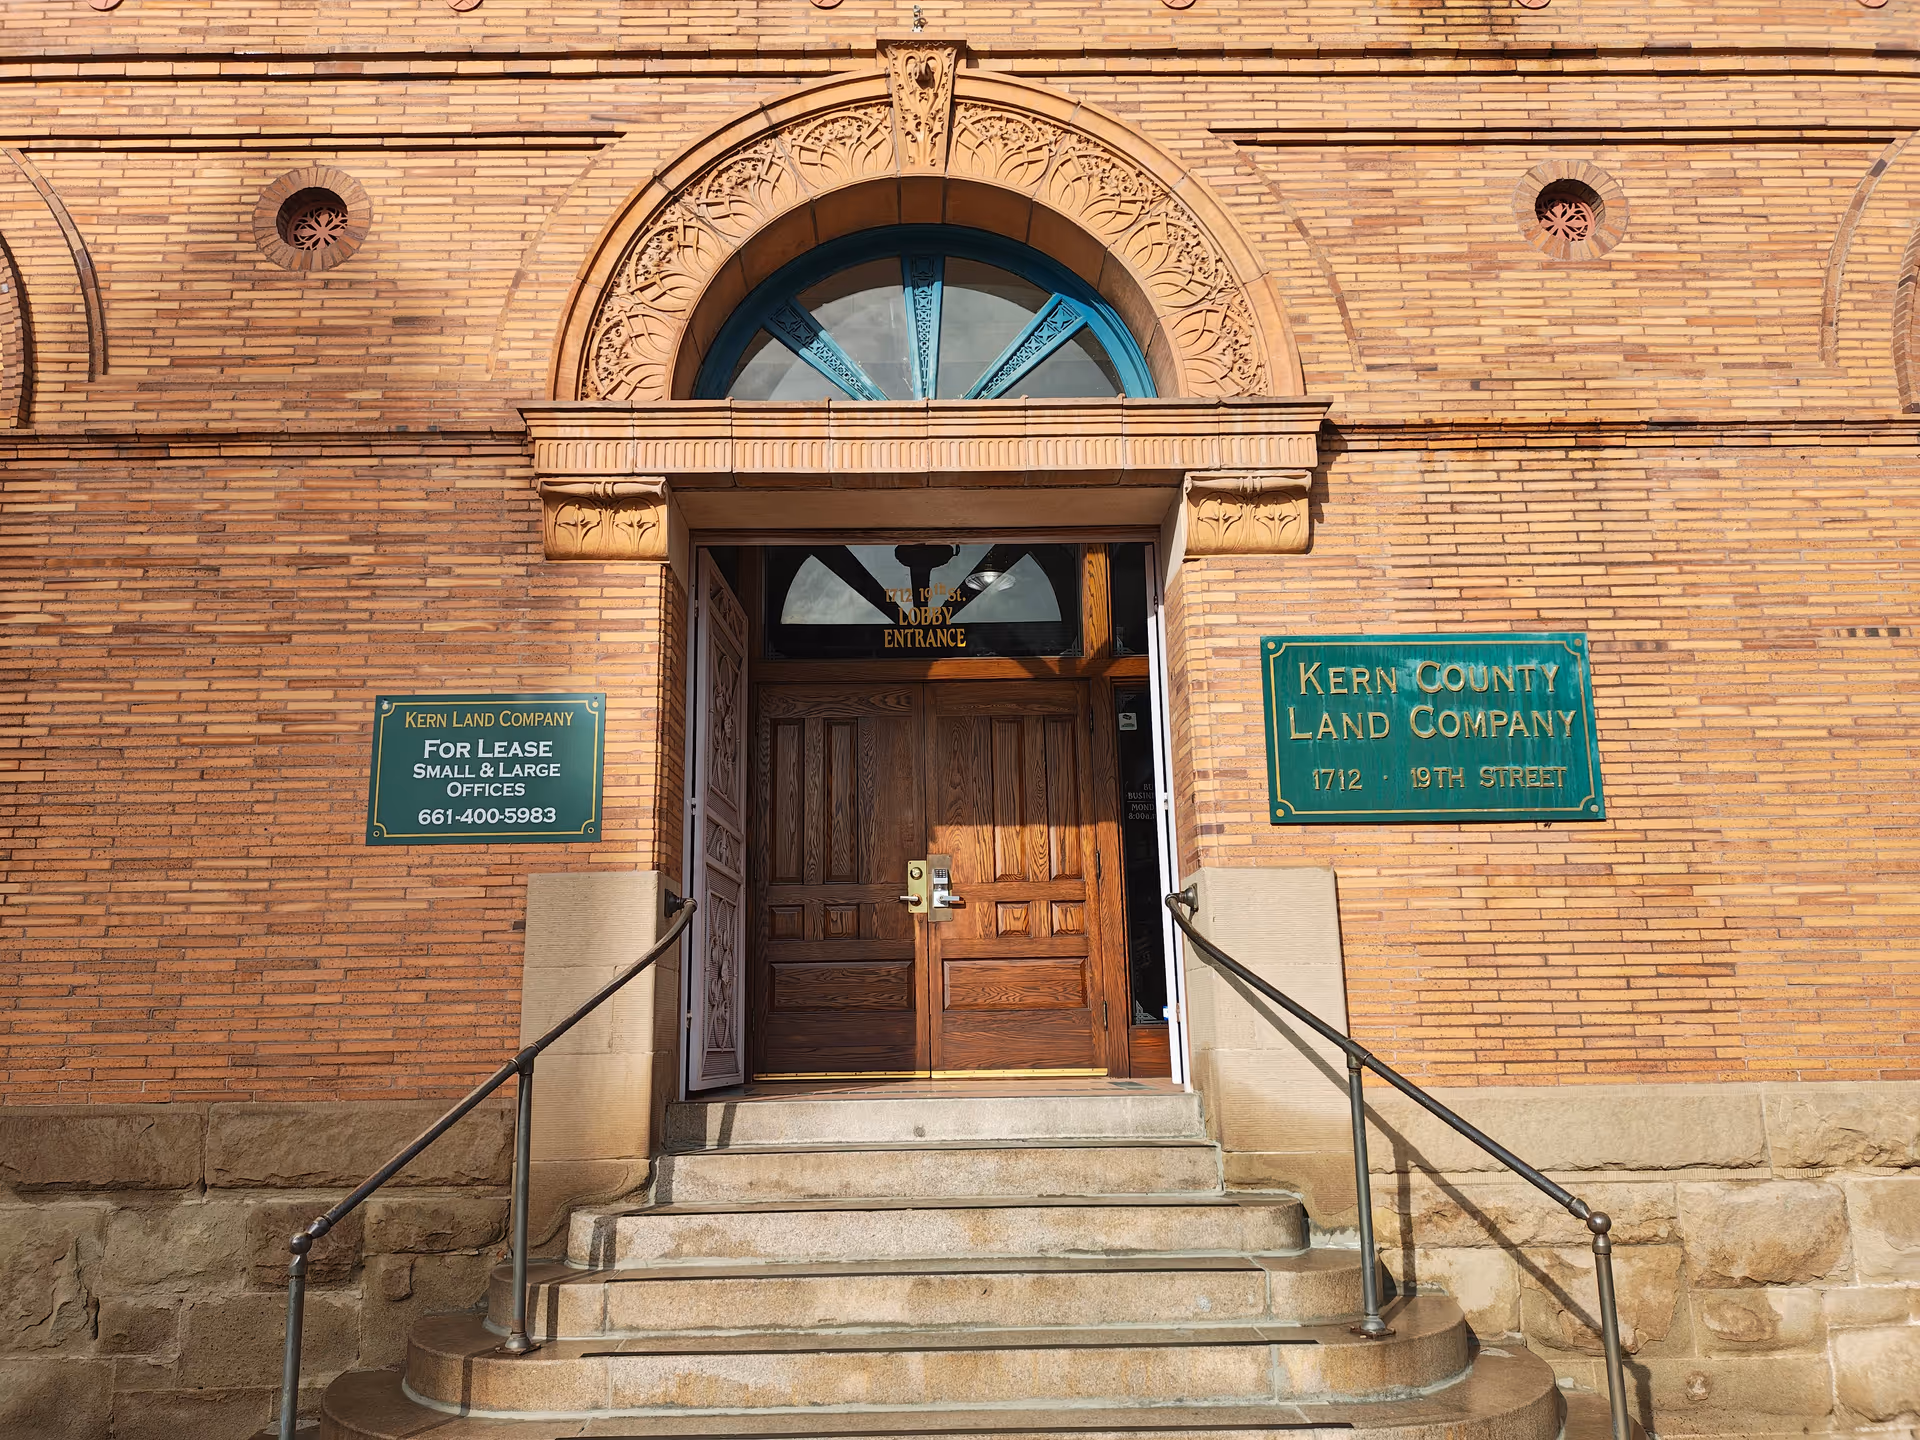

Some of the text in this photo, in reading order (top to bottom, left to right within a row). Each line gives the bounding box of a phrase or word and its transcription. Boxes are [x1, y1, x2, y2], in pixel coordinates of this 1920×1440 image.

[884, 582, 966, 603] 1712 19th St.
[898, 606, 953, 626] LOBBY
[883, 628, 967, 648] ENTRANCE
[1298, 660, 1560, 695] KERN COUNTY
[404, 710, 574, 728] KERN LAND COMPANY
[1287, 705, 1577, 741] LAND COMPANY
[423, 738, 553, 759] FOR LEASE
[413, 762, 561, 779] SMALL & LARGE
[1312, 766, 1568, 791] 1712 19TH STREET
[446, 781, 526, 797] OFFICES
[418, 807, 557, 825] 661-400-5983
